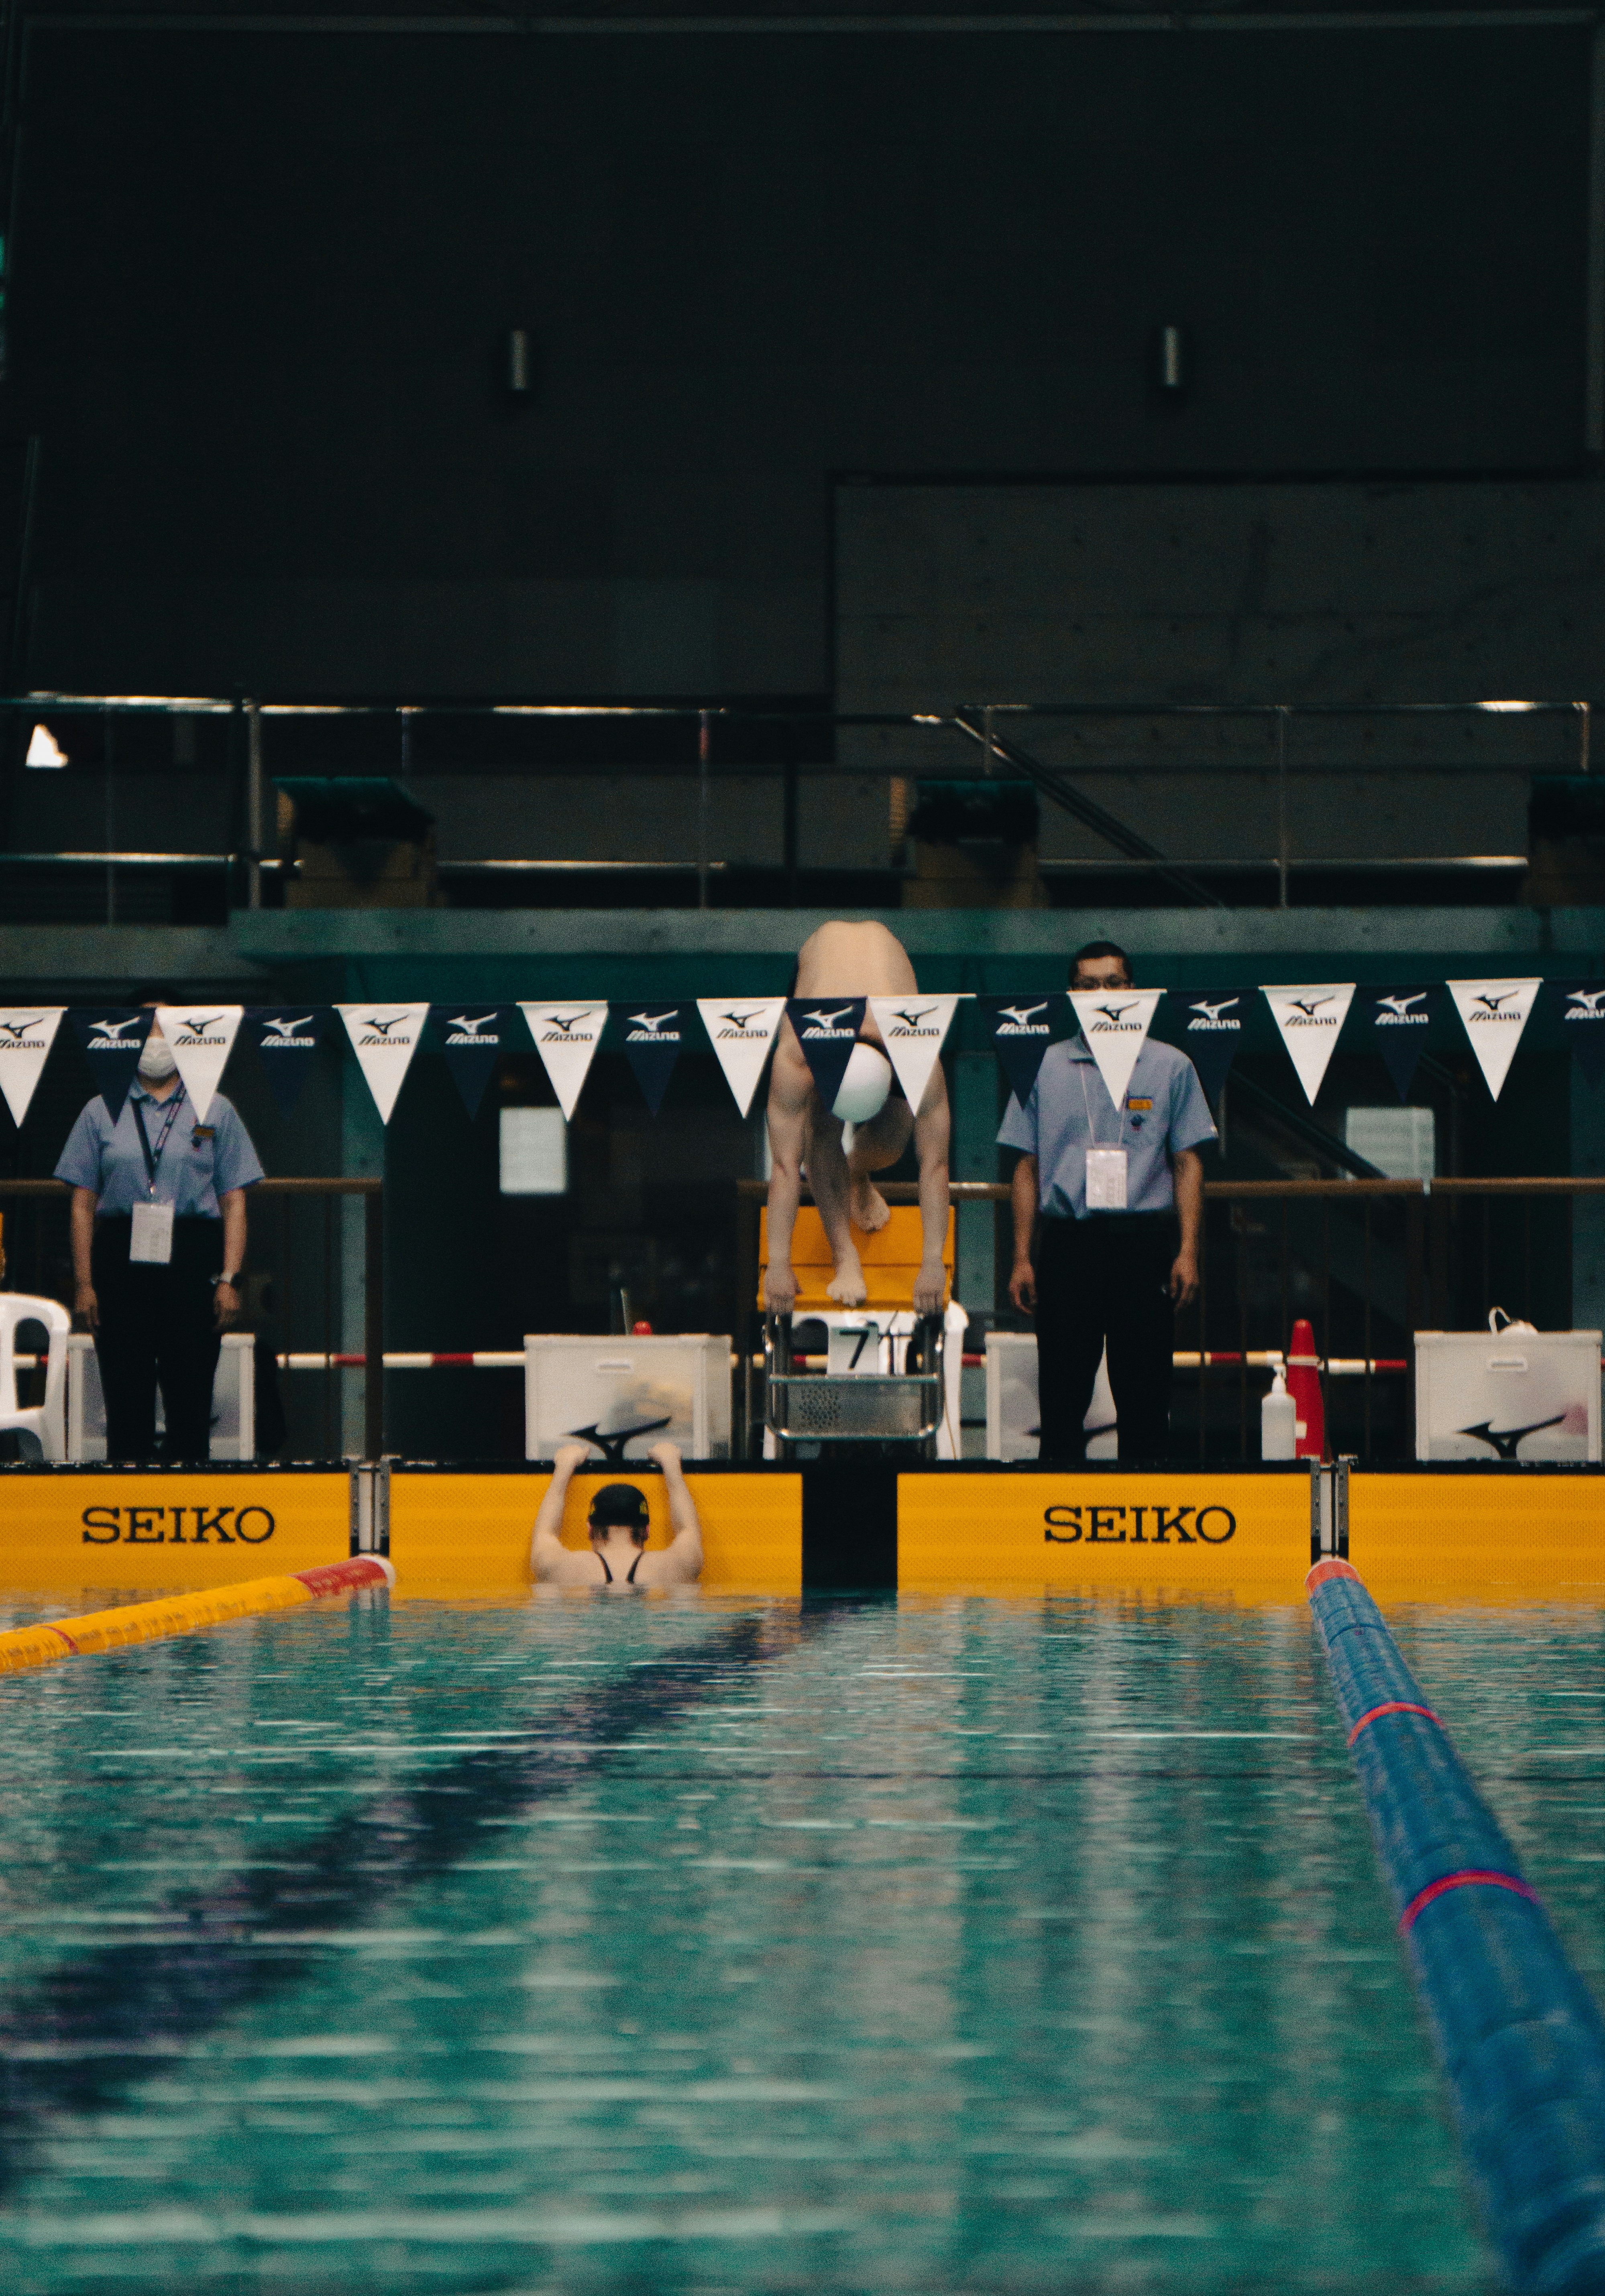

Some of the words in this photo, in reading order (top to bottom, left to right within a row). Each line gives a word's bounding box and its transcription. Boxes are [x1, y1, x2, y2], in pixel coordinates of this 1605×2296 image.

[839, 1329, 869, 1369] 7
[81, 1506, 275, 1544] SEIKO
[1044, 1506, 1236, 1544] SEIKO
